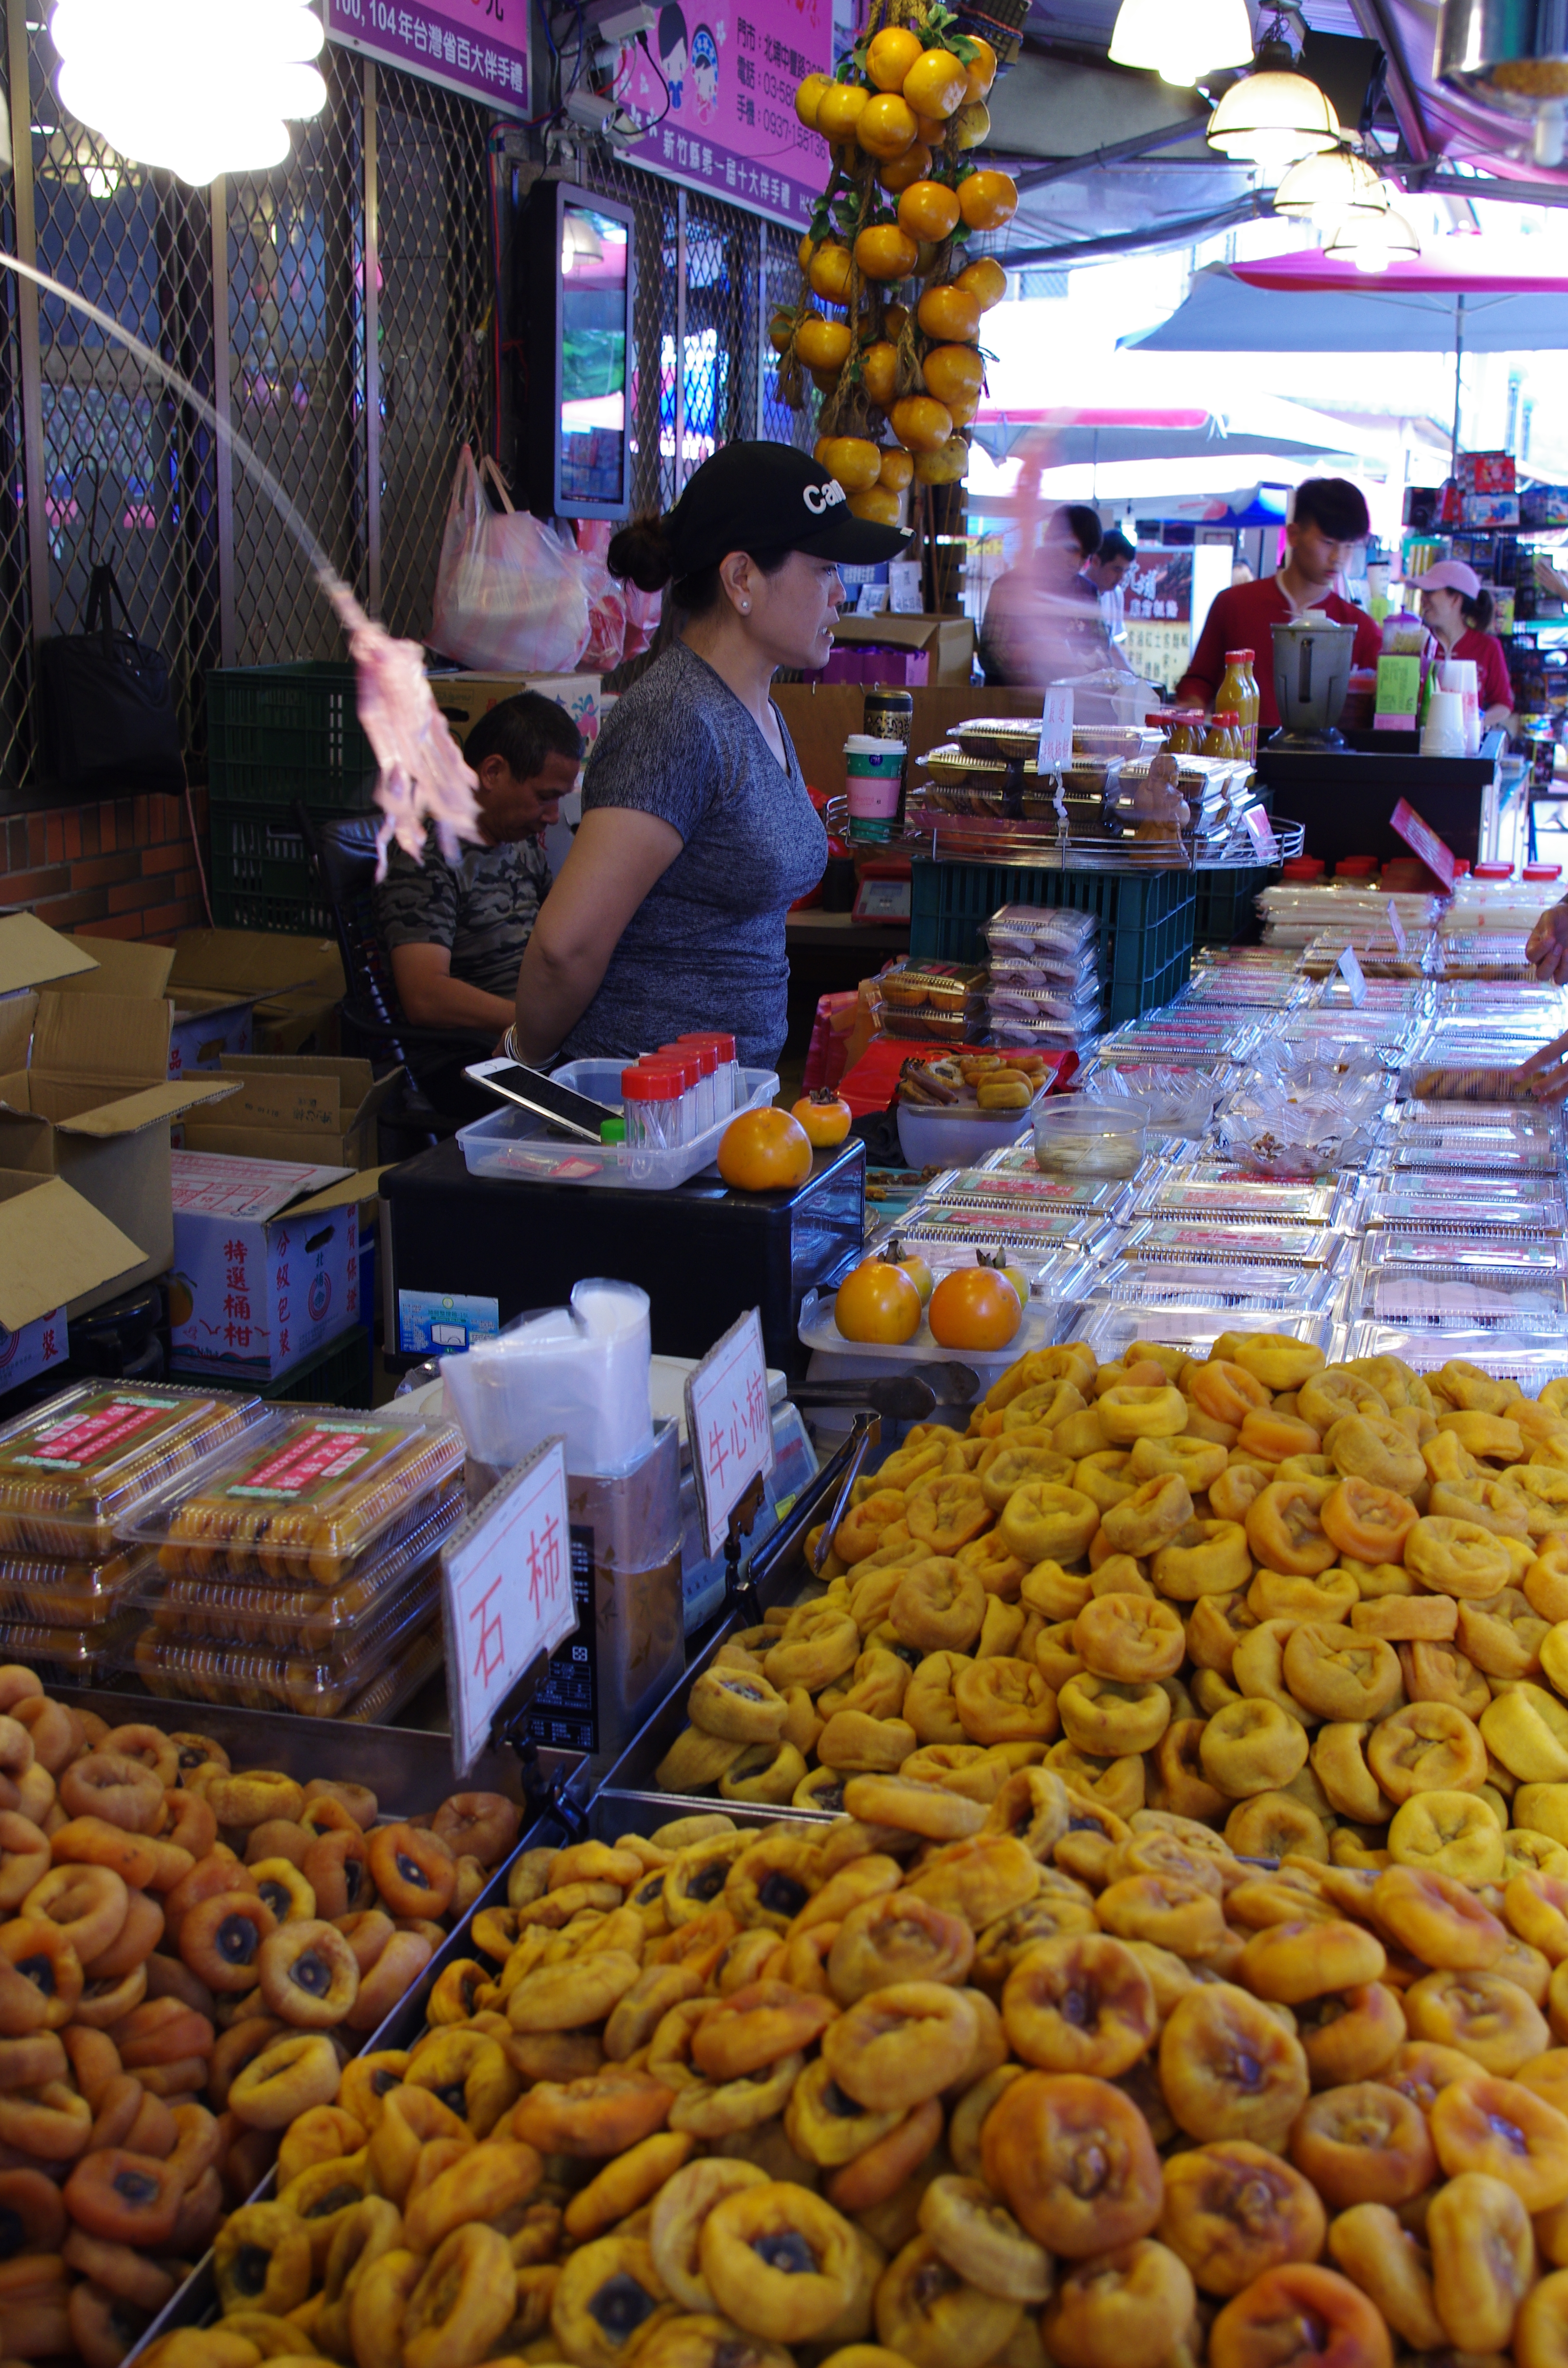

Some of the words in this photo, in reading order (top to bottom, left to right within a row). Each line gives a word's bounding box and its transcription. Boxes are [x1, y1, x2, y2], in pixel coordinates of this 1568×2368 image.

[223, 1239, 253, 1347] 特選桶柑
[710, 1373, 766, 1489] 牛心柿
[469, 1514, 561, 1690] 石柿
